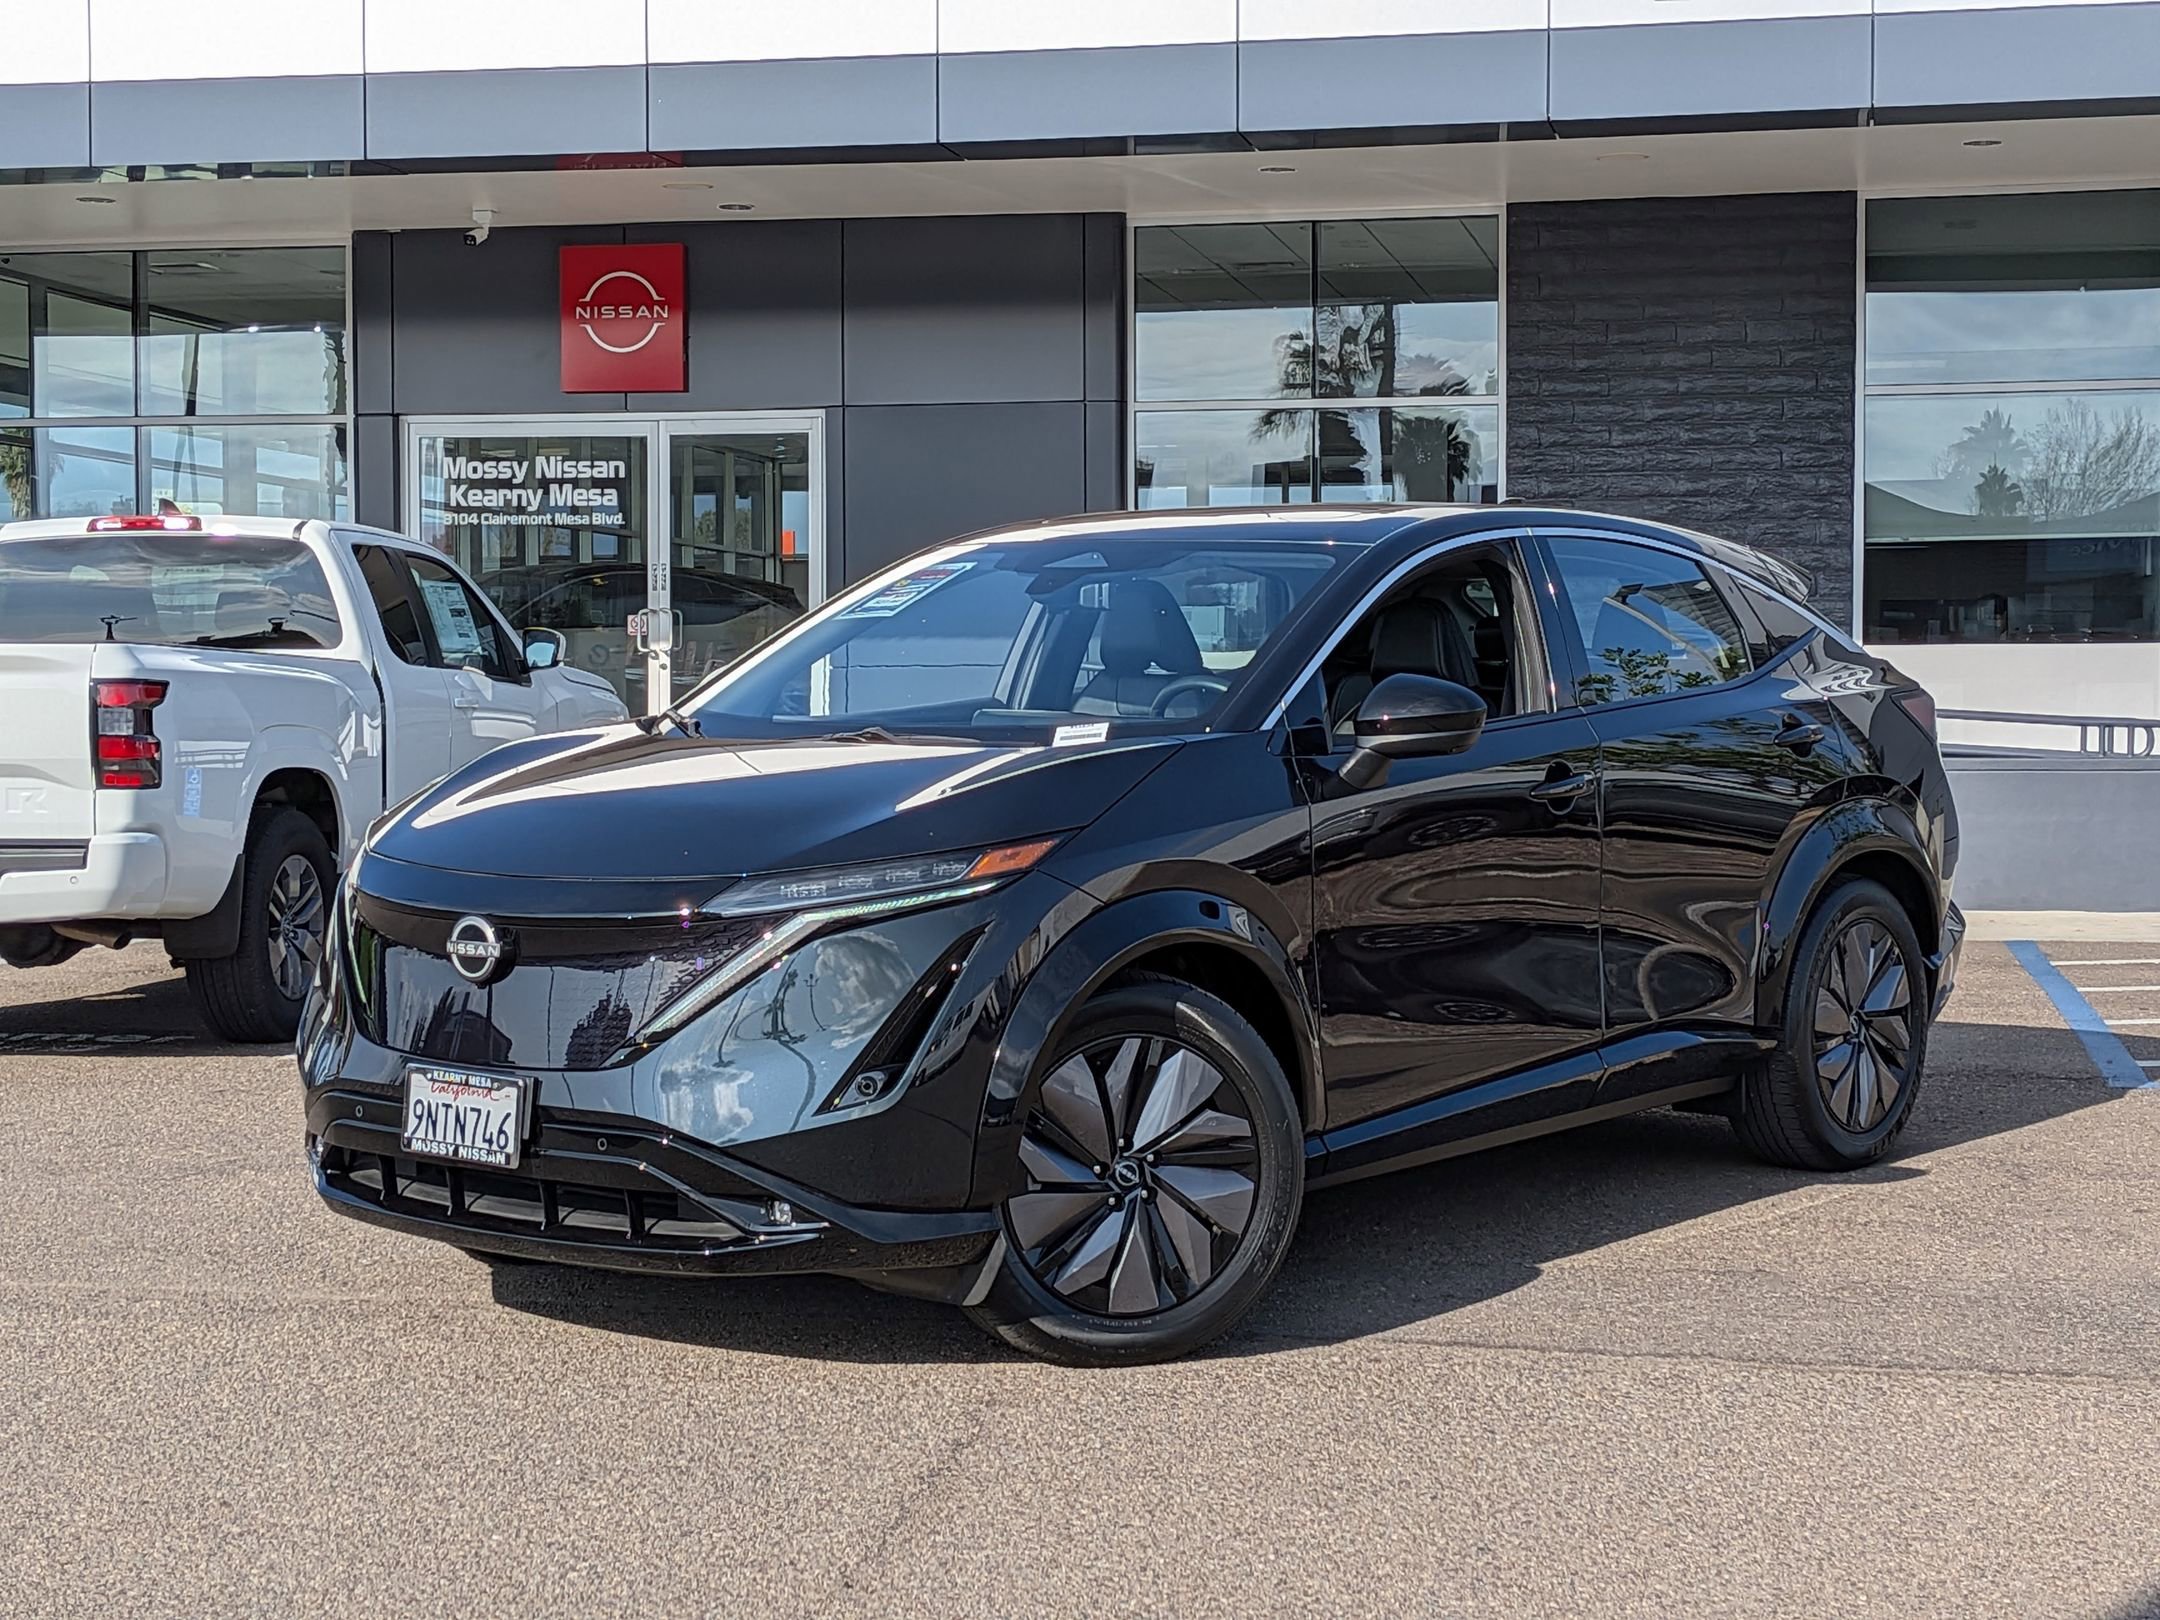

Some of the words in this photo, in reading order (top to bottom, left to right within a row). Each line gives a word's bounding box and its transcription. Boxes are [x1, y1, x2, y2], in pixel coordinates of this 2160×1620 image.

[575, 304, 668, 319] NISSAN
[442, 455, 529, 484] Mossy
[535, 455, 626, 479] Nissan
[449, 484, 544, 512] Kearny
[549, 483, 618, 507] Mesa
[480, 511, 553, 526] Clairemont
[554, 512, 590, 526] Mesa
[592, 512, 626, 525] Blvd.
[446, 942, 499, 957] NISSAN
[433, 1070, 467, 1083] KEARNY
[468, 1075, 492, 1088] MESA
[430, 1080, 500, 1102] California
[410, 1098, 512, 1150] 9NTN746
[411, 1139, 456, 1156] MOSSY
[458, 1145, 506, 1165] NISSAN
